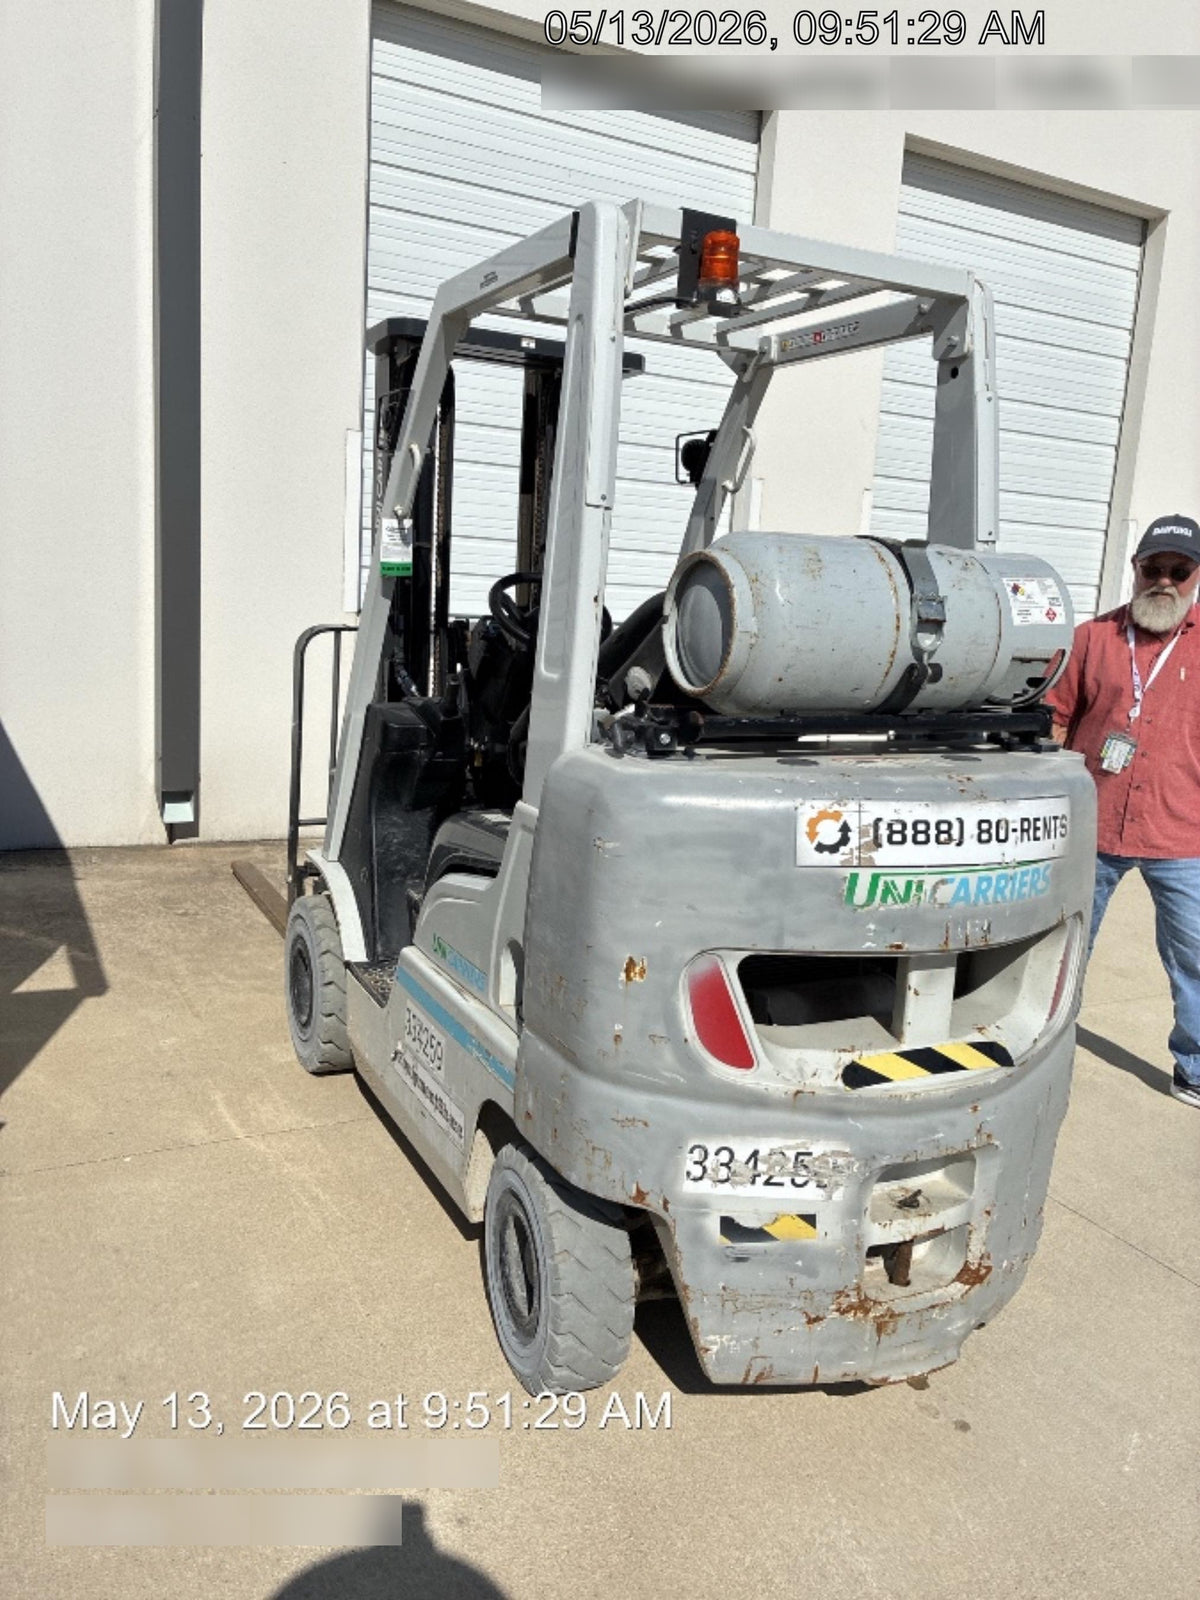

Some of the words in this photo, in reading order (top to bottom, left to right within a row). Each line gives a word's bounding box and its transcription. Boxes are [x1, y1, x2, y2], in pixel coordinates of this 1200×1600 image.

[872, 816, 965, 848] (888)
[976, 814, 1068, 844] 80-RENTS
[843, 864, 1053, 909] UNICARRIERS
